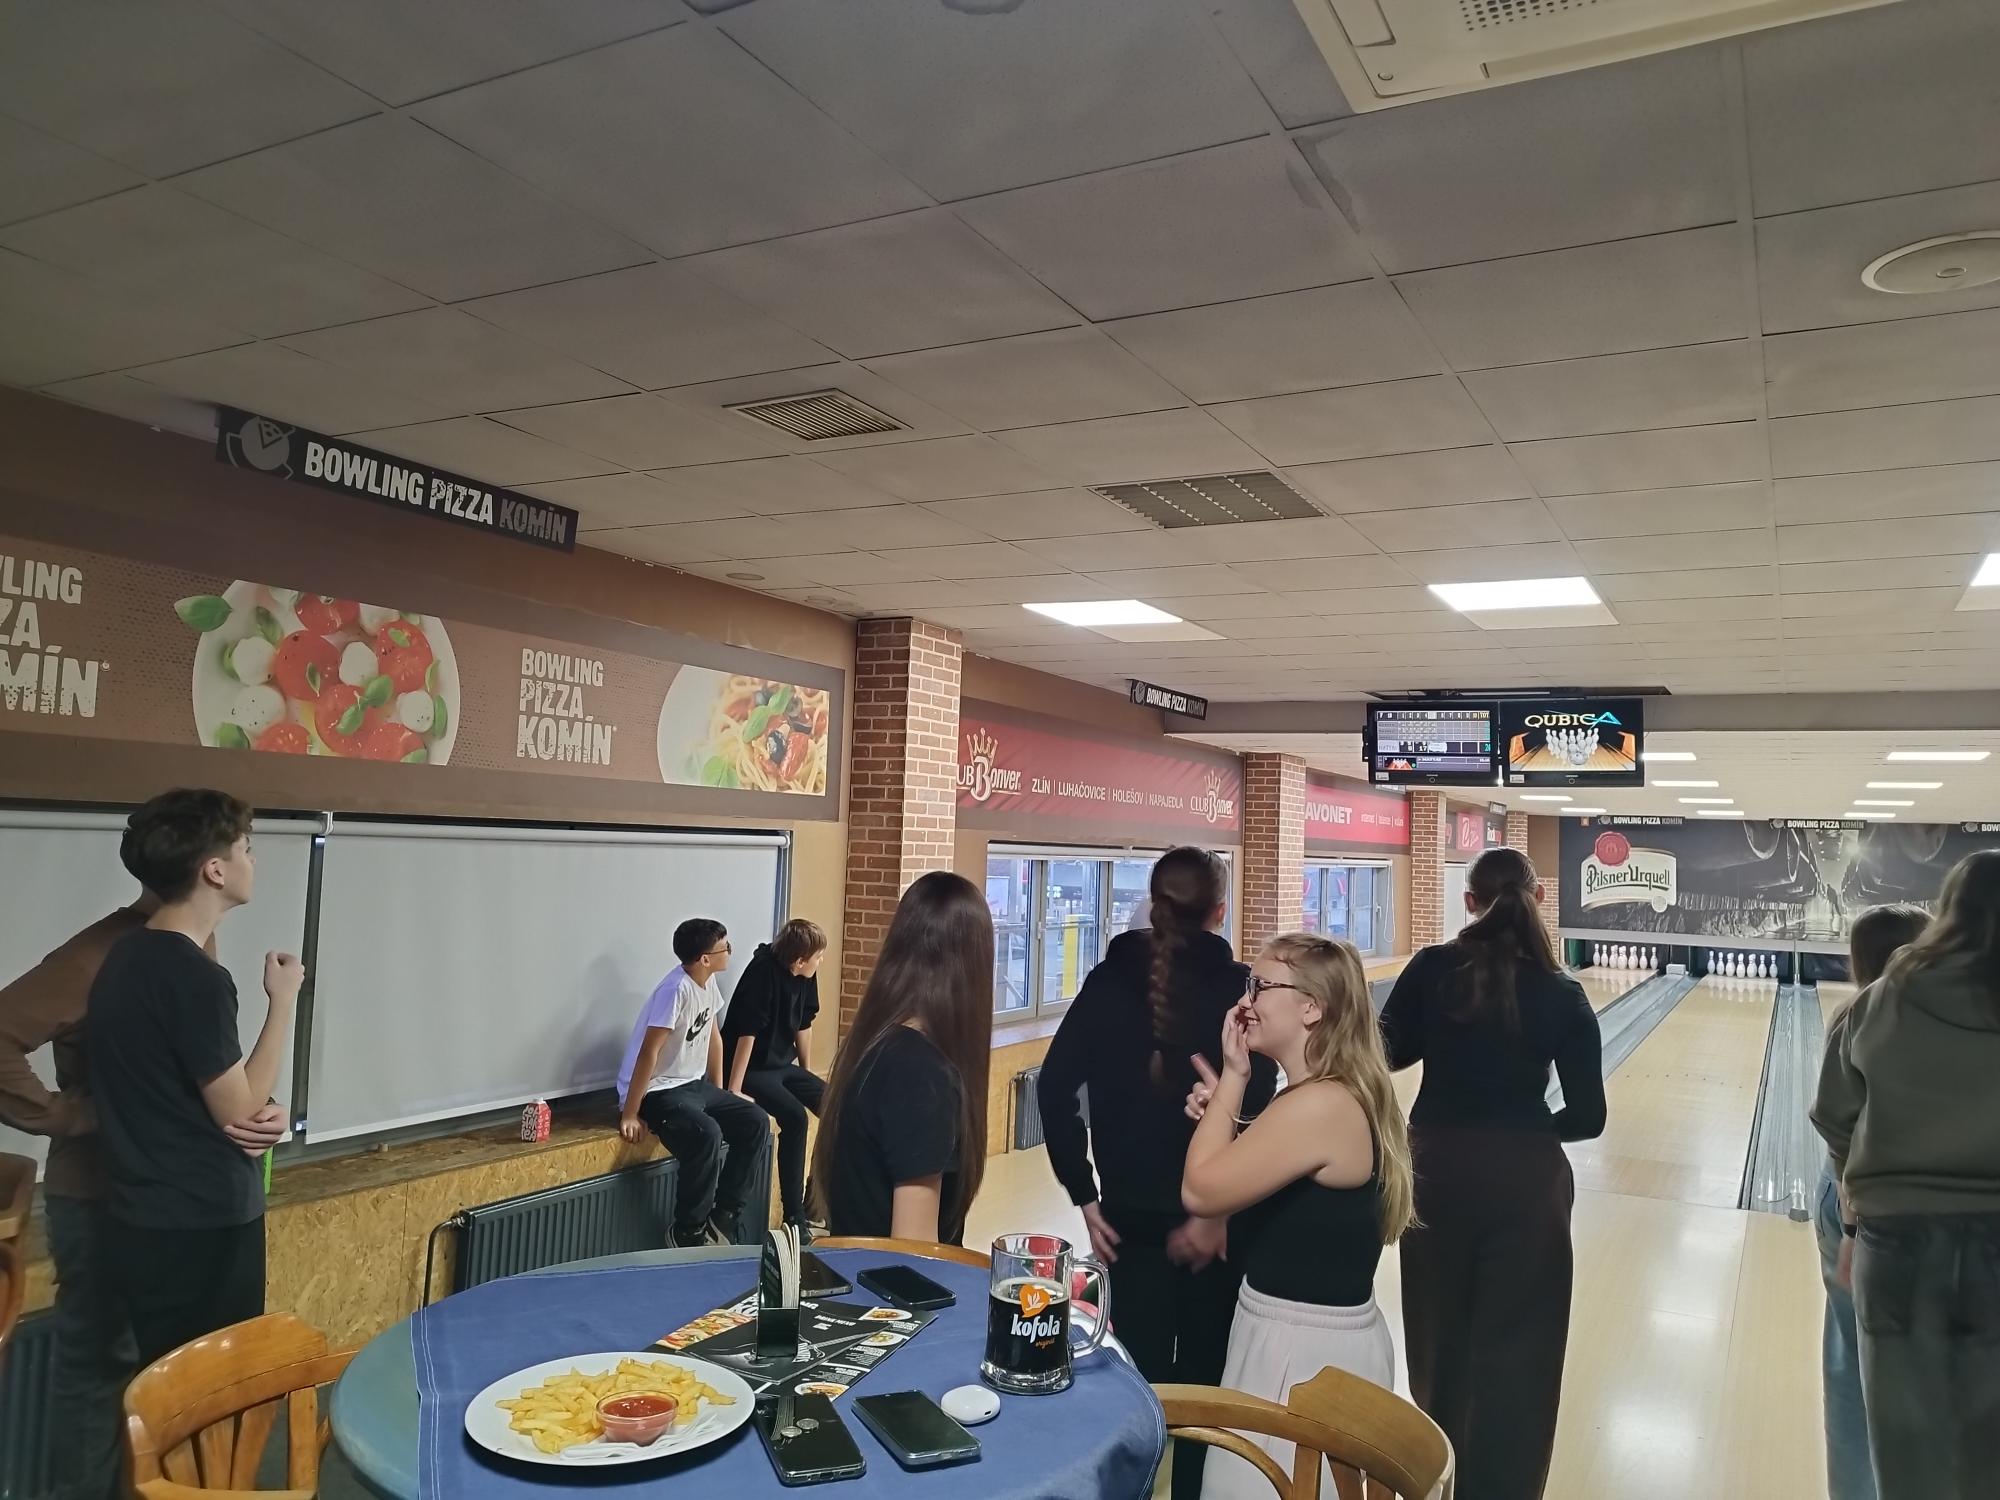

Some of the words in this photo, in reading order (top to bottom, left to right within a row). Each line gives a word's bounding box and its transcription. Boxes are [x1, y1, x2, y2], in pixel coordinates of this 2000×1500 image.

[305, 442, 424, 505] BOWLING
[429, 477, 493, 525] PIZZA
[499, 498, 567, 544] KOMÍN
[0, 555, 82, 604] LING
[521, 648, 604, 687] BOWLING
[519, 678, 584, 719] PIZZA
[1146, 687, 1172, 709] BOWLING
[1170, 694, 1187, 713] PIZZA
[516, 714, 612, 766] KOMÍN
[1031, 776, 1051, 794] ZLÍN
[1058, 781, 1106, 800] LUHAČOVICE
[1112, 787, 1144, 805] HOLEŠOV
[1149, 793, 1184, 809] NAPAJEDLA
[1190, 795, 1208, 812] CLUB
[1305, 801, 1353, 825] AVONET
[1613, 816, 1641, 825] BOWLING
[1642, 816, 1660, 825] PIZZA
[1787, 819, 1818, 828] BOWLING
[1820, 820, 1840, 829] PIZZA
[1586, 864, 1629, 895] Pilsner
[1627, 864, 1671, 891] Urquell
[1010, 1313, 1061, 1344] kofola
